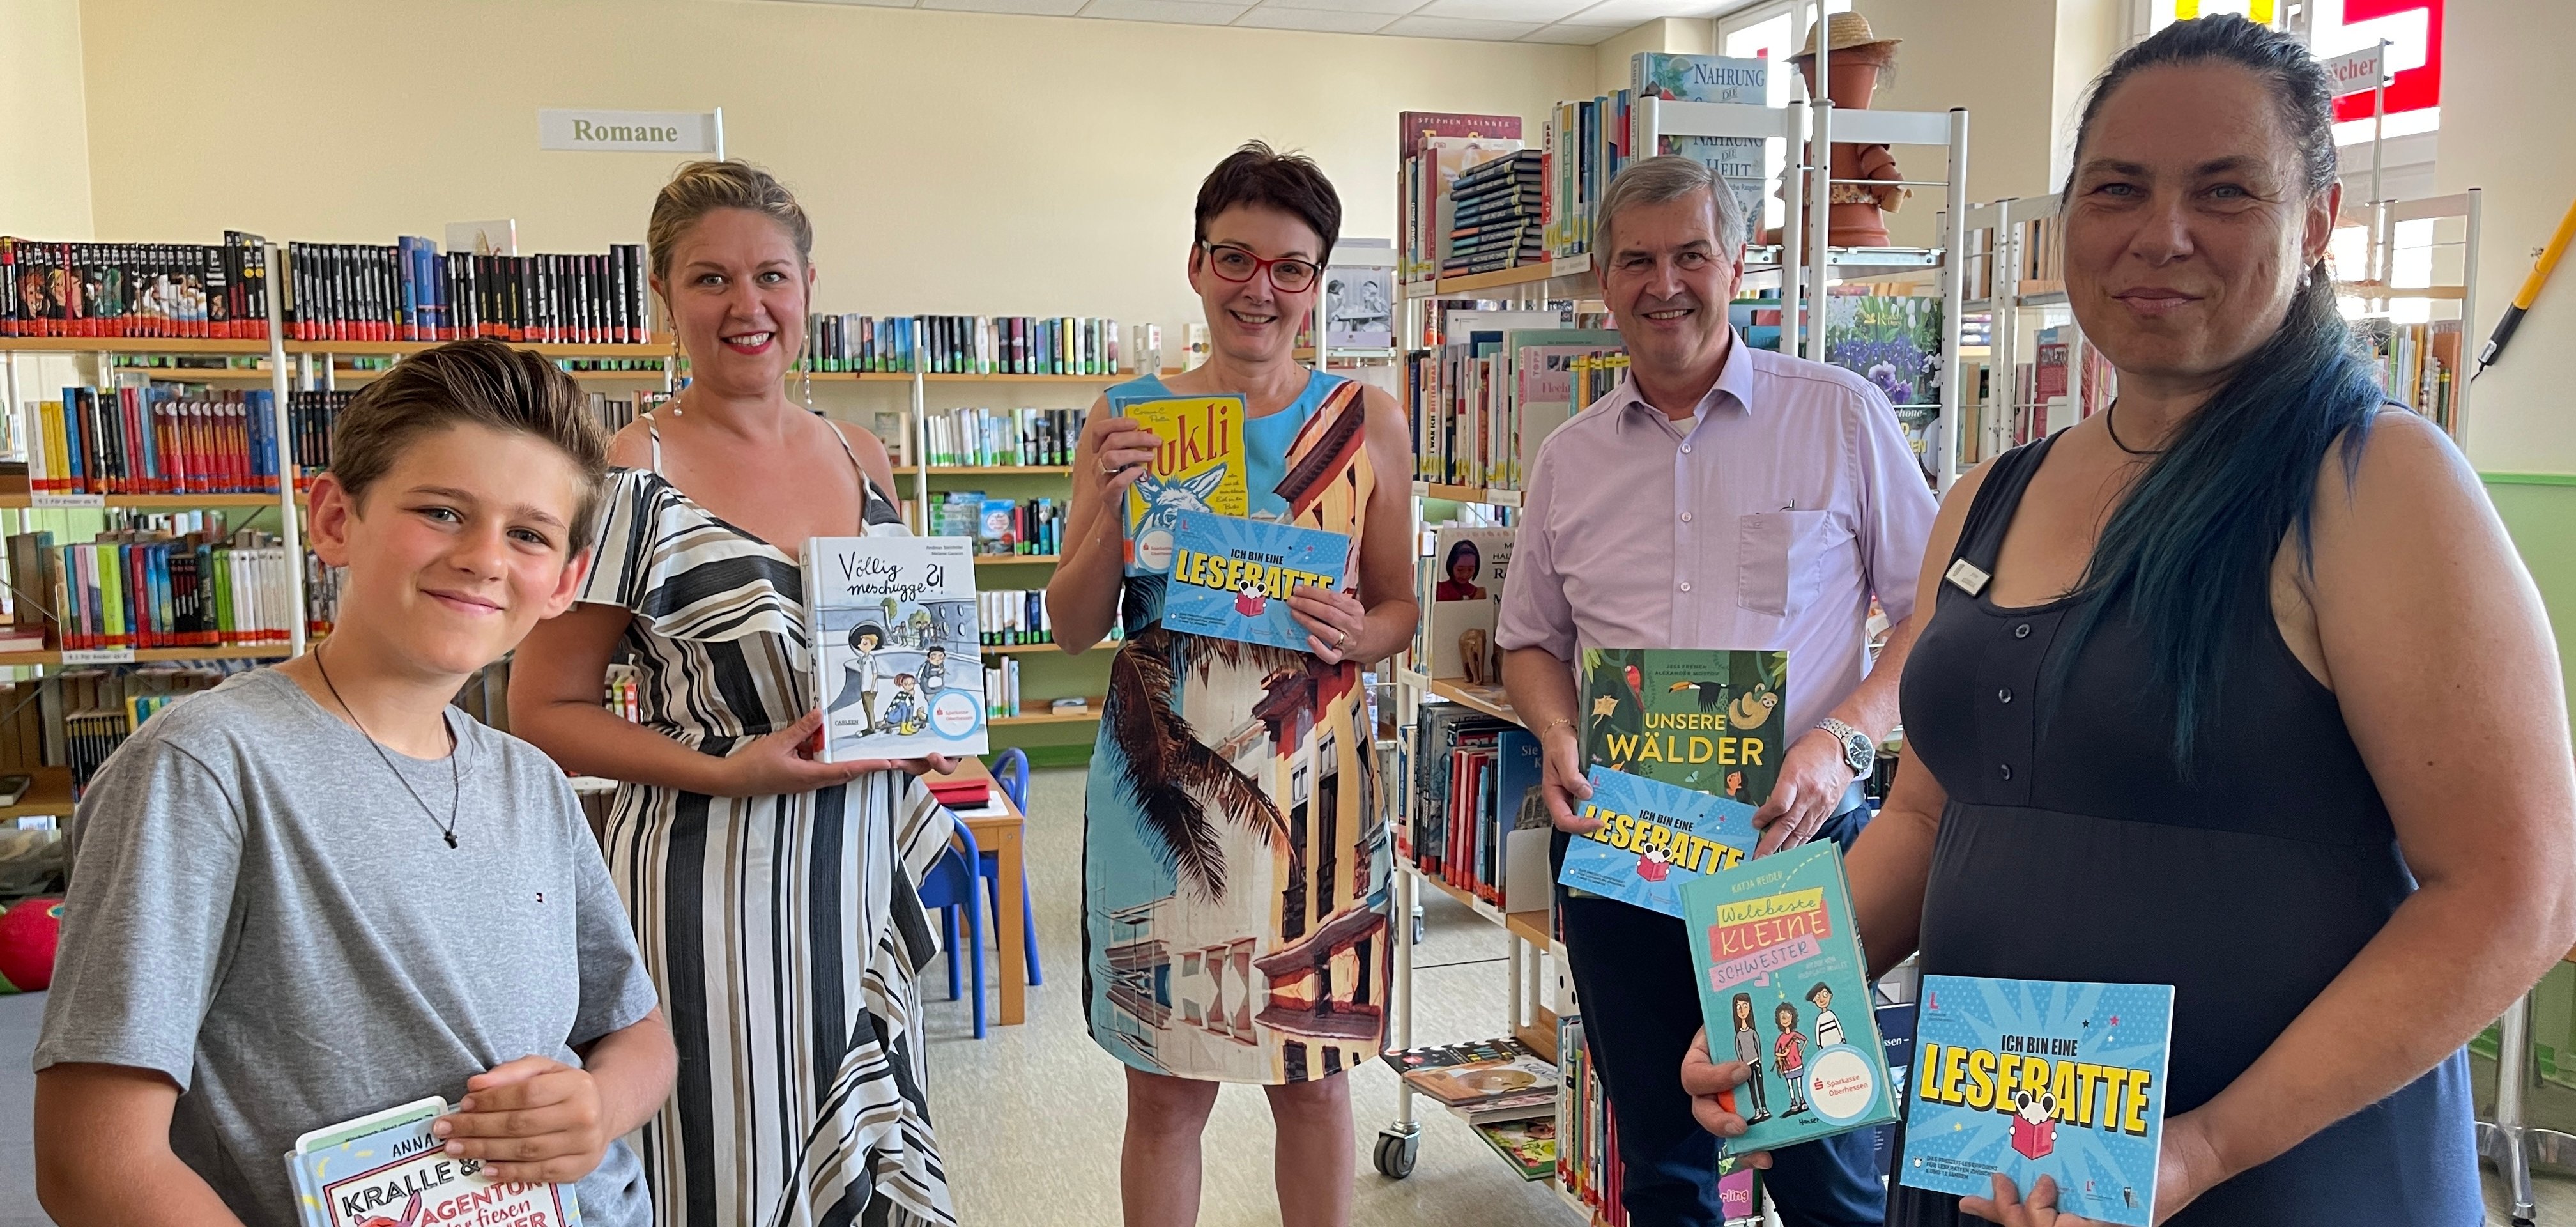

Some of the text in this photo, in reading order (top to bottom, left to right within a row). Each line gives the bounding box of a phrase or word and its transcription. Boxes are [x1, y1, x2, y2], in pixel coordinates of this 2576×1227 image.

[1694, 63, 1765, 87] NAHRUNG
[1722, 87, 1738, 100] DIE
[572, 119, 678, 142] Romane
[1721, 148, 1737, 161] DIE
[838, 551, 903, 581] Völlig
[1230, 548, 1284, 566] ICH BIN EINE
[847, 580, 926, 602] meschugge
[1645, 713, 1726, 730] UNSERE
[1522, 745, 1538, 757] Sie
[1607, 732, 1765, 766] WÄLDER
[1639, 809, 1694, 832] ICH BIN EINE
[1731, 879, 1754, 894] KATJA
[1721, 897, 1817, 923] Weltbeste
[1721, 910, 1827, 957] KLEINE
[1717, 940, 1810, 984] SCHWESTER
[2001, 1034, 2078, 1057] ICH BIN EINE
[1826, 1074, 1860, 1088] Sparkasse
[1829, 1081, 1869, 1097] Oberhessen
[1920, 1043, 2151, 1136] LESERATTE
[392, 1132, 434, 1158] ANNA
[341, 1157, 481, 1218] KRALLE &
[475, 1199, 532, 1226] fiesen
